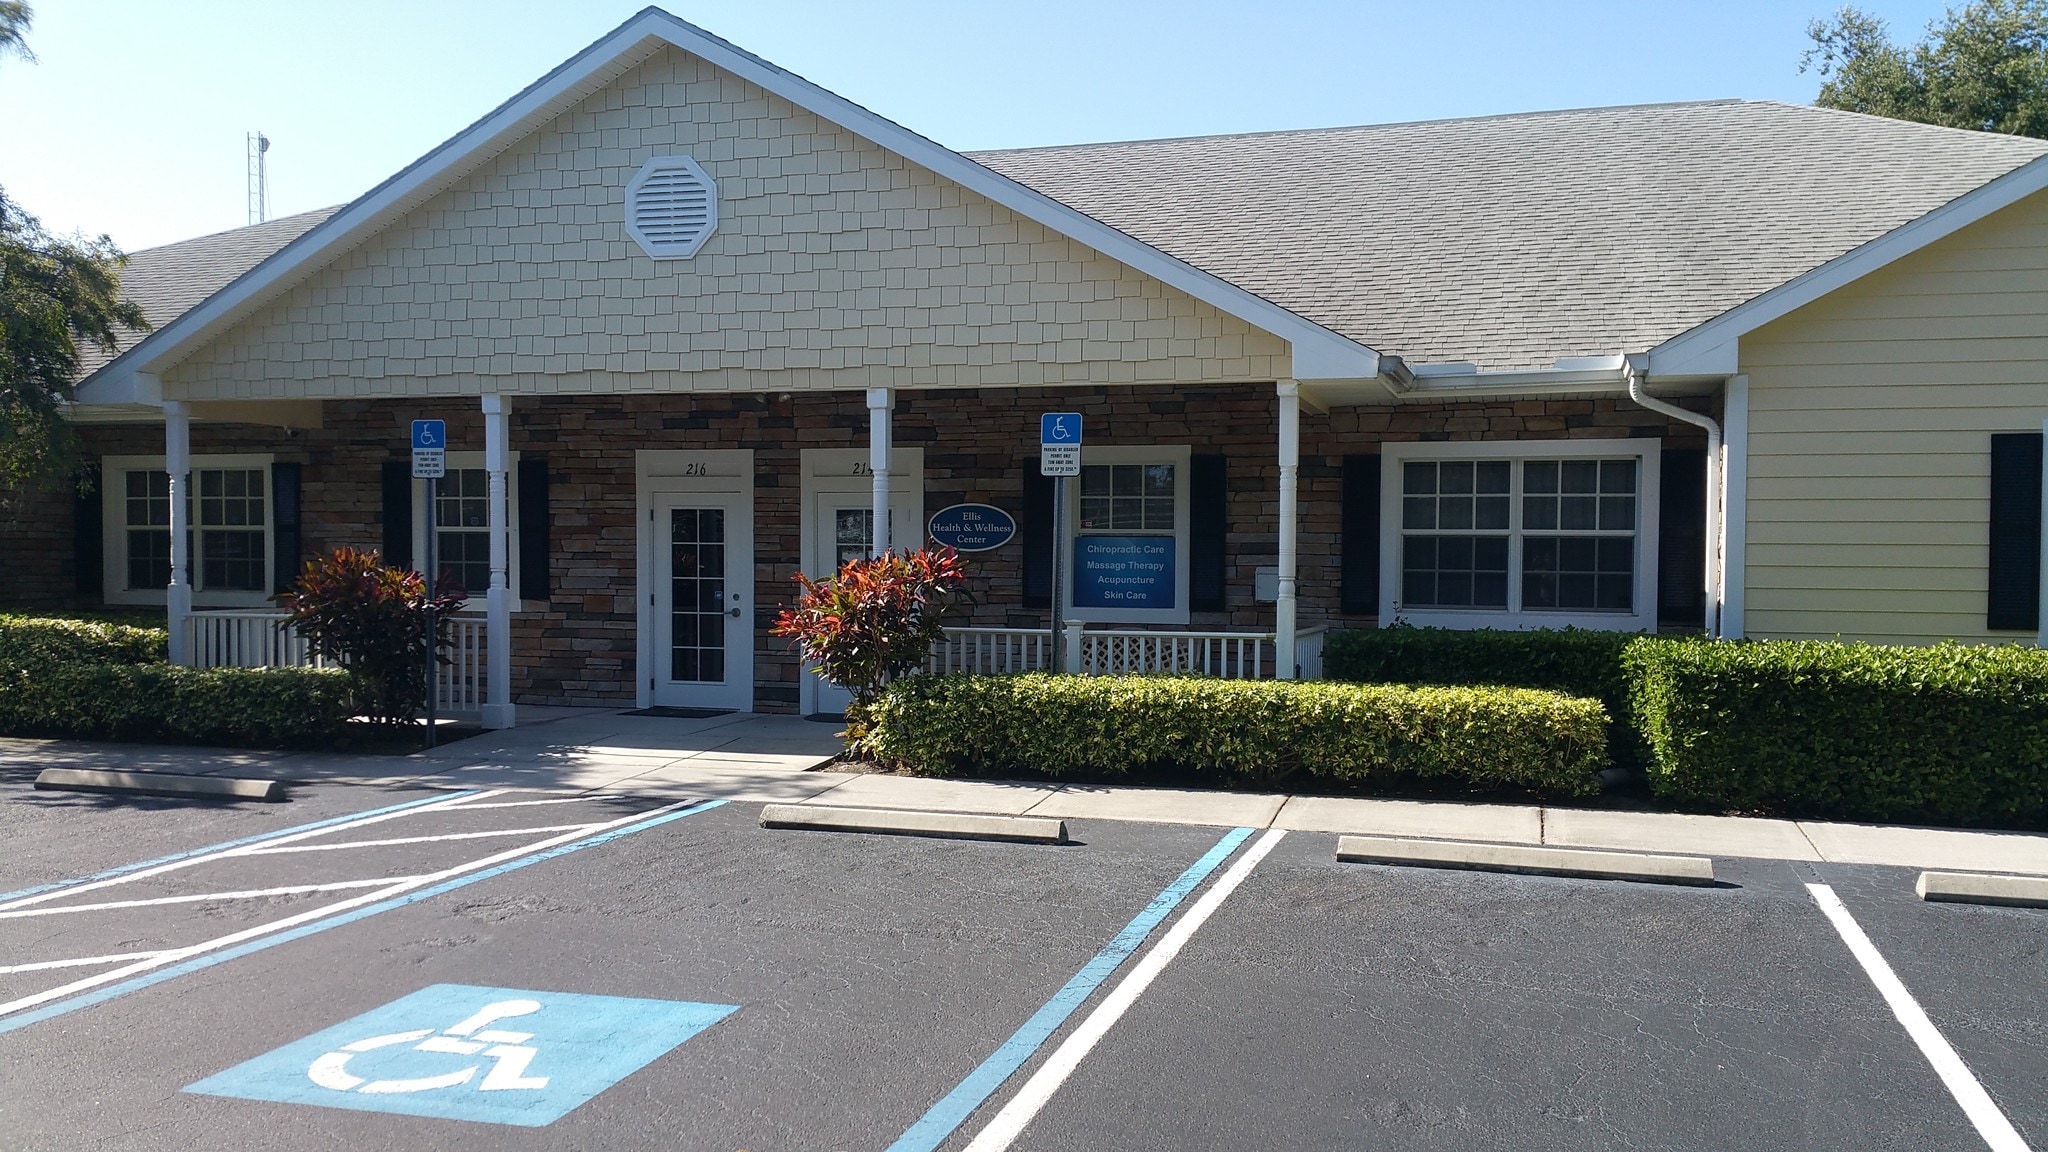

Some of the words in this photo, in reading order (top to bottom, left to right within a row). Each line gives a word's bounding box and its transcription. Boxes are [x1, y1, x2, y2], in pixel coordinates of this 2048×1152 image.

[686, 462, 706, 476] 216
[963, 512, 981, 521] Ellis
[933, 523, 961, 532] Health
[963, 523, 972, 532] &
[974, 523, 1012, 533] Wellness
[957, 535, 986, 543] Center
[1087, 545, 1141, 555] Chiropractic
[1143, 545, 1165, 554] Care
[1087, 561, 1126, 571] Massage
[1128, 561, 1164, 572] Therapy
[1097, 575, 1155, 585] Acupuncture
[1104, 591, 1124, 599] Skin
[1126, 591, 1147, 600] Care
